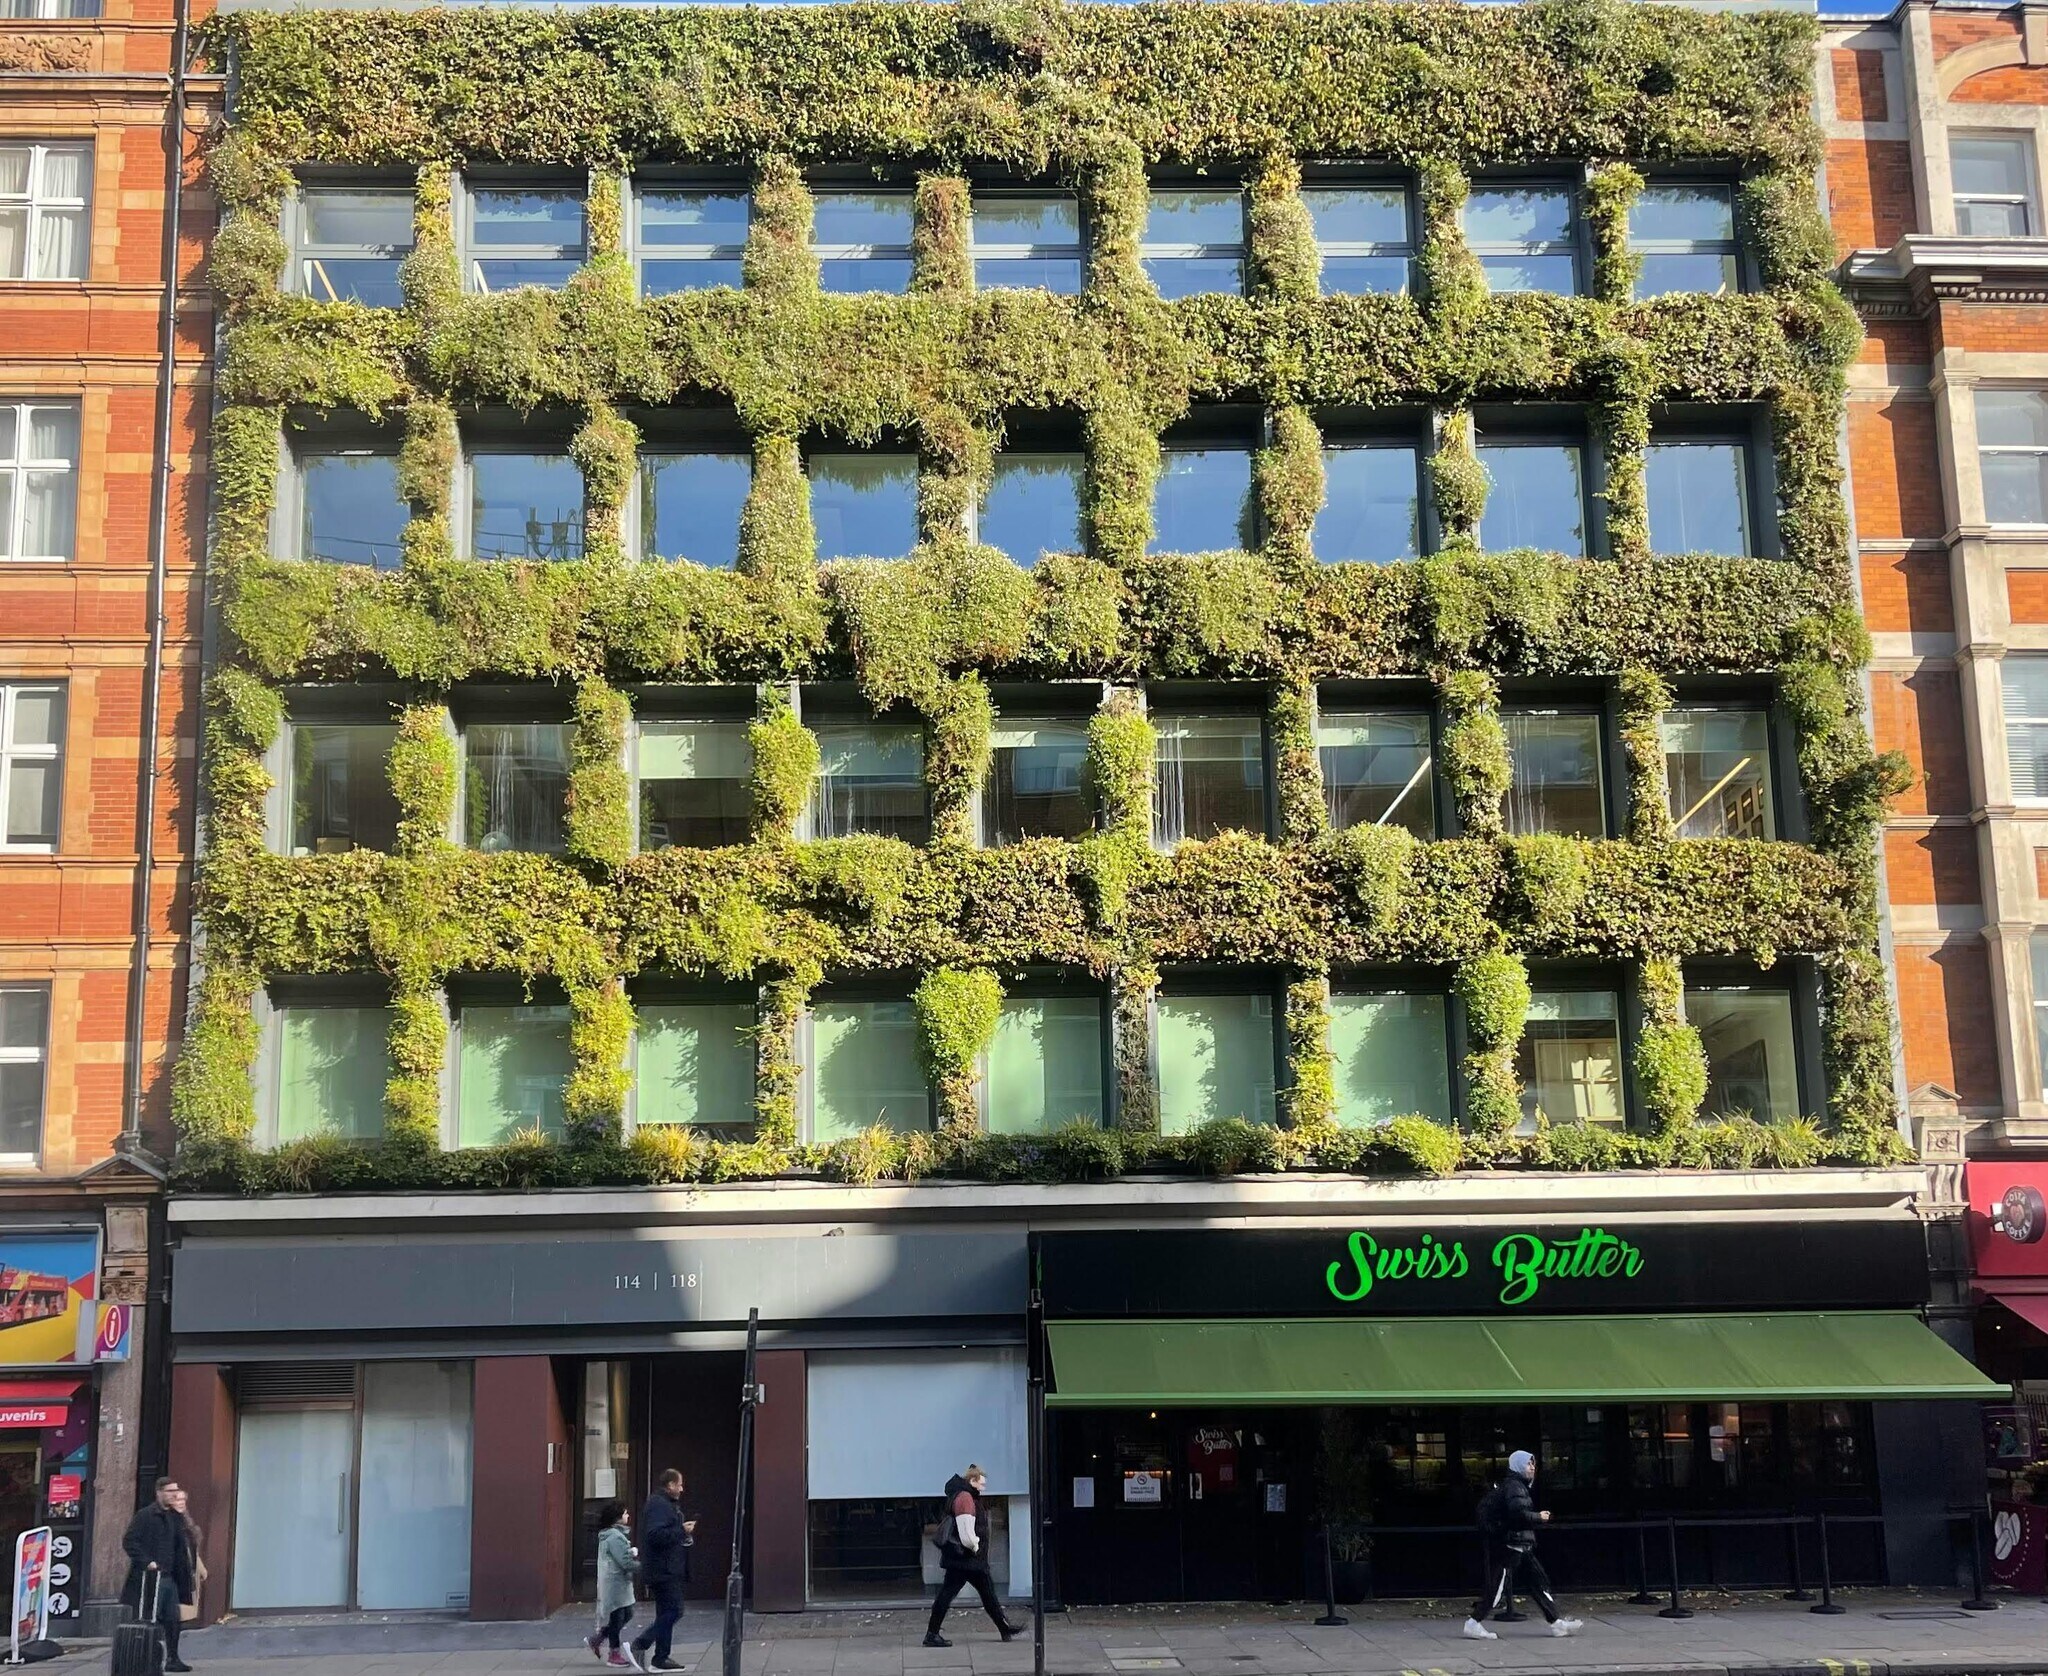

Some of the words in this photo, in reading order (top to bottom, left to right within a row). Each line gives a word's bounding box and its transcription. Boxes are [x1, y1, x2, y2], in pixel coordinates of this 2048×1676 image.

[2005, 1191, 2026, 1207] COSTA
[2005, 1220, 2031, 1238] COFFEE
[1326, 1231, 1469, 1301] Swiss
[1492, 1228, 1644, 1304] Butter
[615, 1275, 641, 1289] 114
[671, 1273, 697, 1288] 118
[1195, 1428, 1224, 1443] Swiss
[1202, 1439, 1232, 1455] Butter
